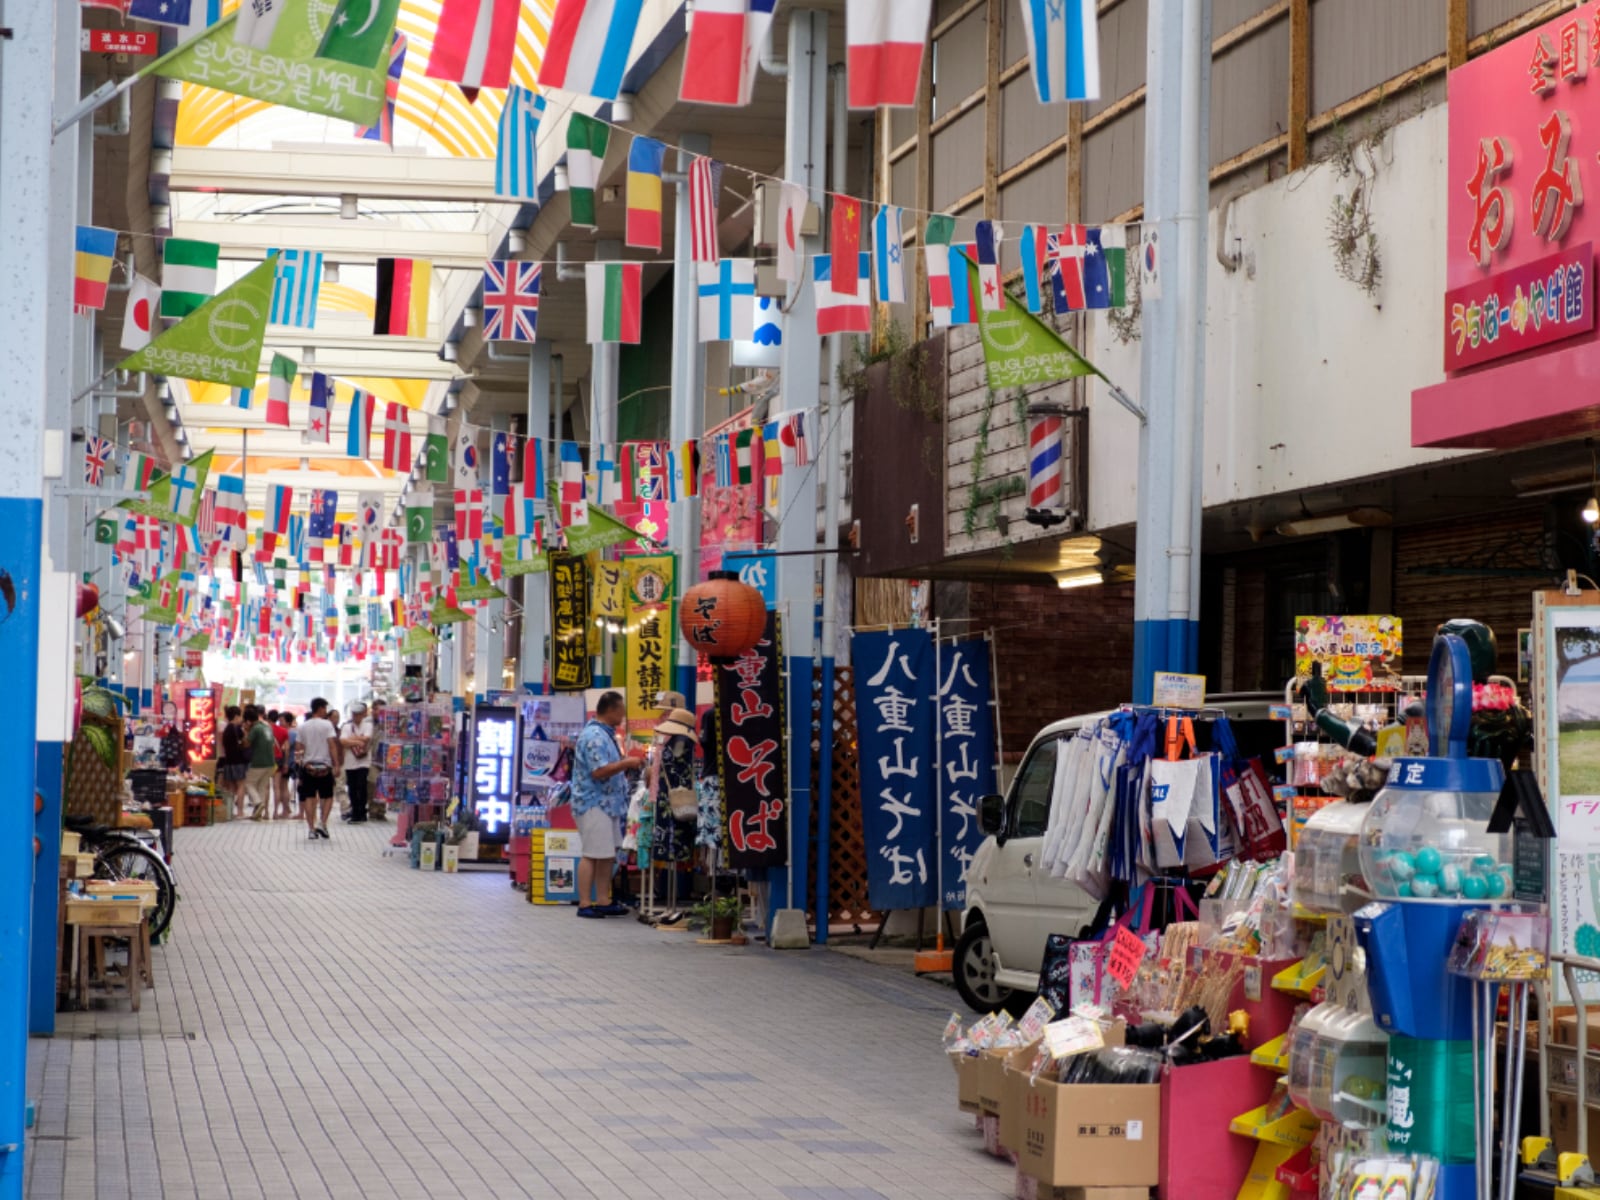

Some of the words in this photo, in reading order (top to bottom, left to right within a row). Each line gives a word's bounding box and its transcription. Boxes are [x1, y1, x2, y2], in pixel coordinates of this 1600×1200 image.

[189, 60, 285, 96] ユーグレナ
[295, 84, 344, 113] モール
[317, 68, 379, 101] MALL
[1467, 110, 1600, 267] おみ
[1451, 261, 1584, 356] うちなーみやげ館
[214, 359, 251, 374] MALL
[693, 597, 721, 644] そば
[475, 719, 515, 833] 割引中
[722, 638, 783, 852] 重山そば
